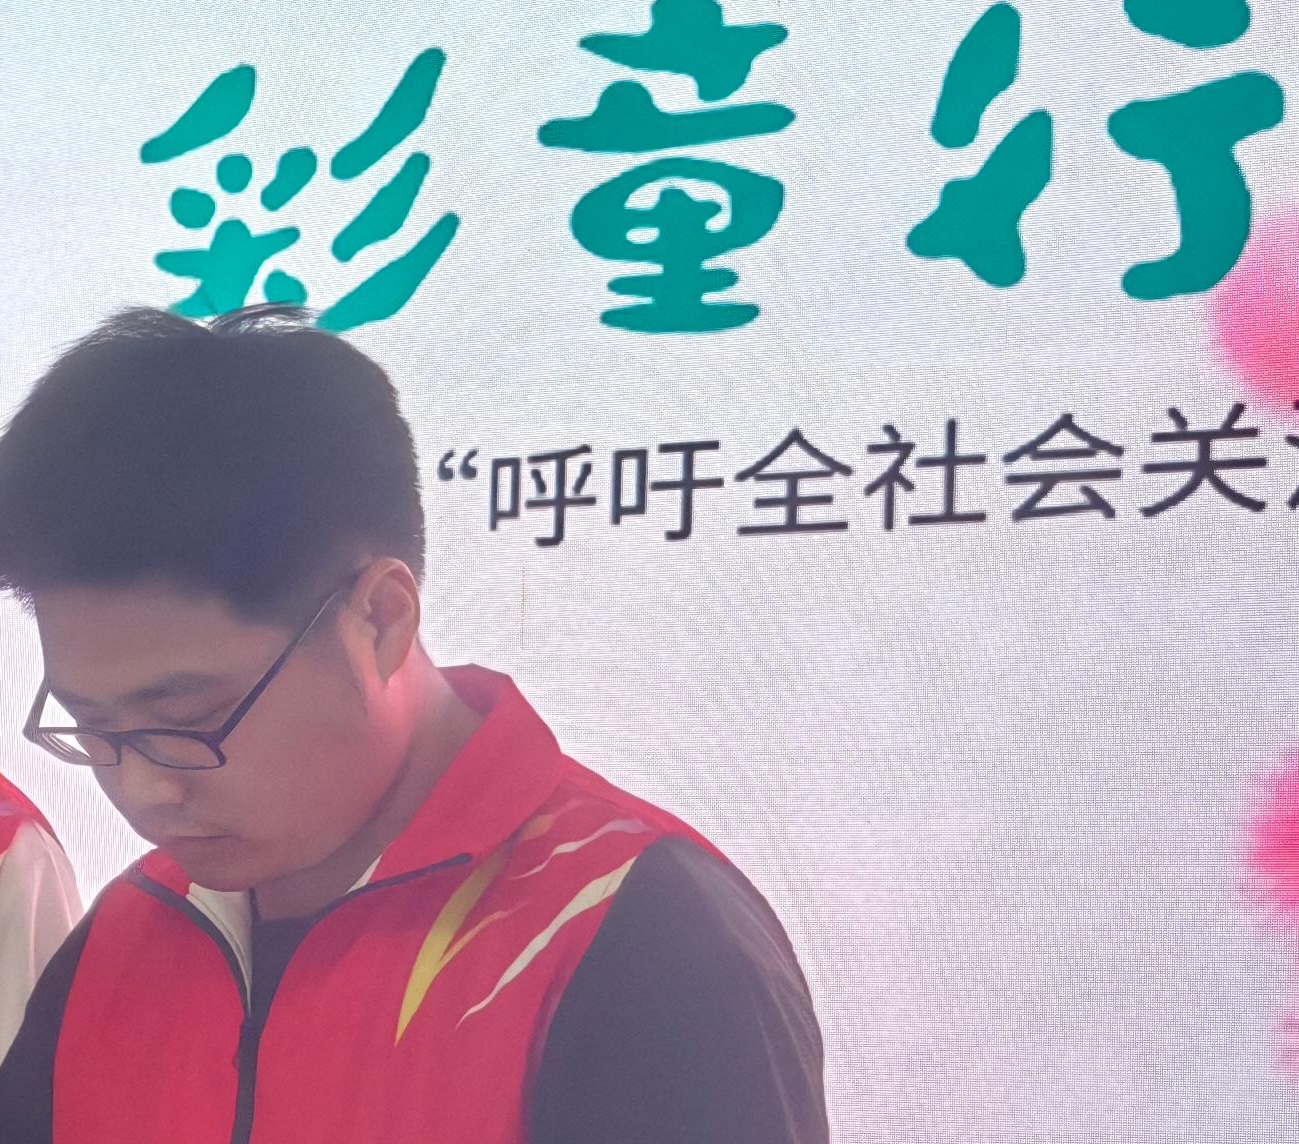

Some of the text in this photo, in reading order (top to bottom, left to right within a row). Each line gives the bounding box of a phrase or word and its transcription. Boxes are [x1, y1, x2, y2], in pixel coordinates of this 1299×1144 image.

[436, 398, 1299, 549] “呼吁全社会关
